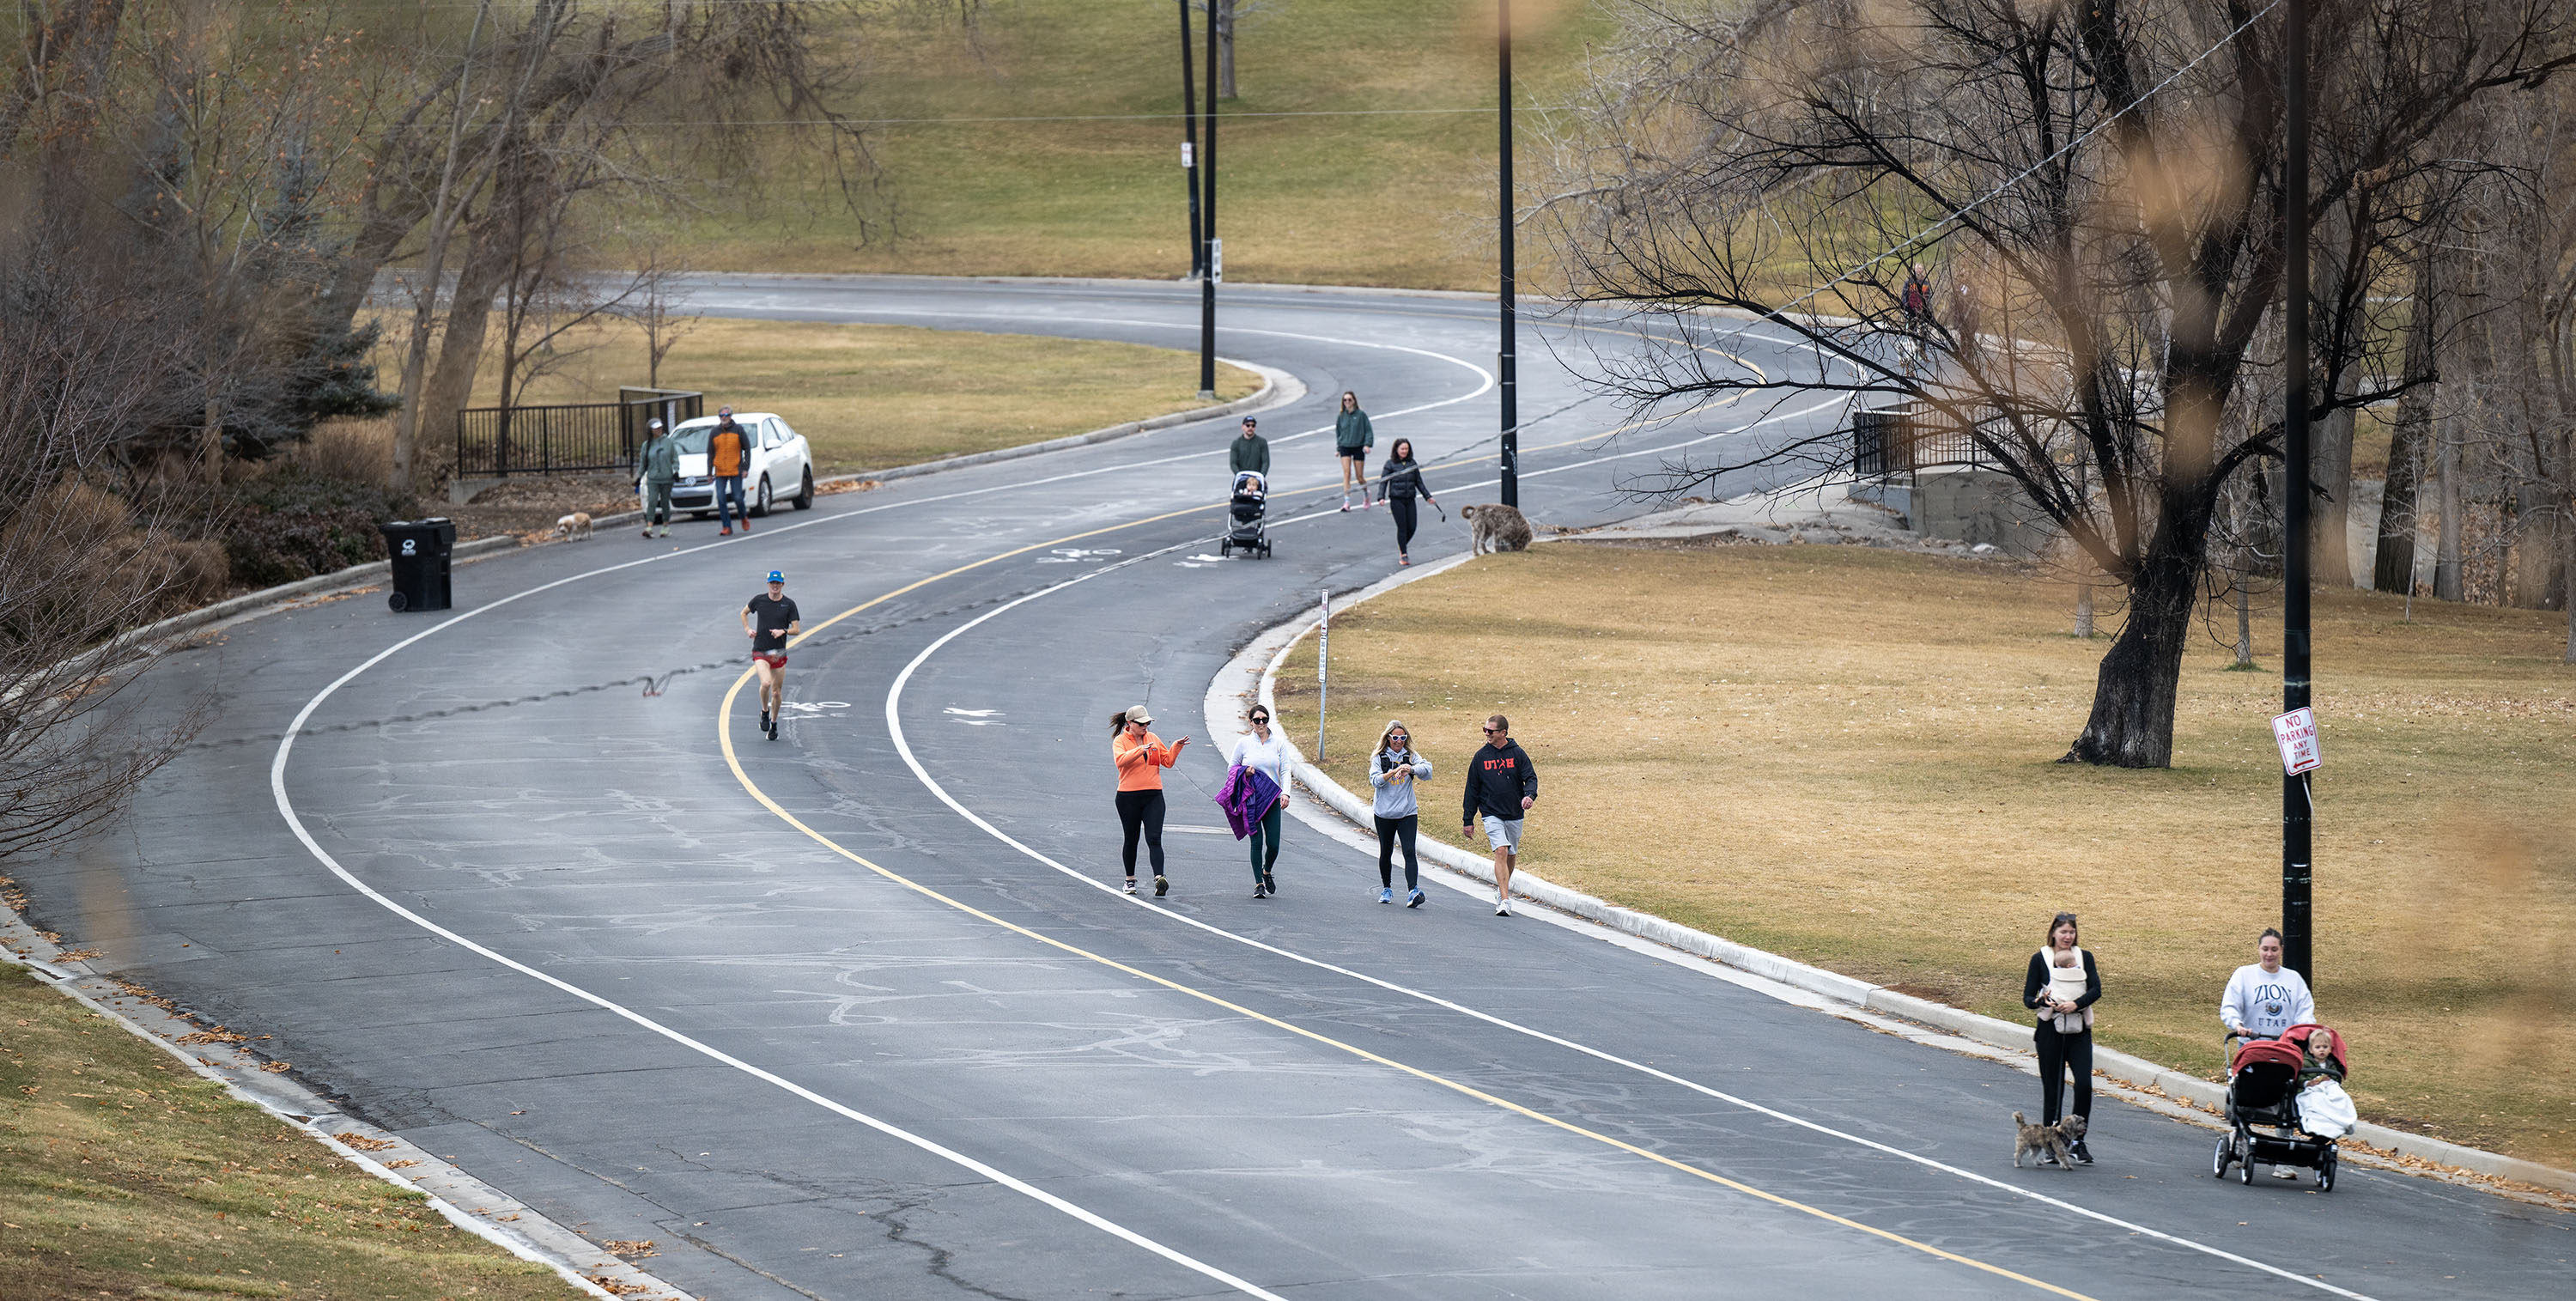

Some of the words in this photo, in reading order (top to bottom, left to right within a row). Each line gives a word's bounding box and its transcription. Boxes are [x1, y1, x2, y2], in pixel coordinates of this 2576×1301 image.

[2285, 715, 2301, 728] NO
[2281, 726, 2313, 744] PARKING
[2293, 739, 2308, 751] ANY
[2294, 748, 2311, 759] TIME
[2254, 984, 2292, 1006] ZION
[2258, 1018, 2287, 1027] UTAH
